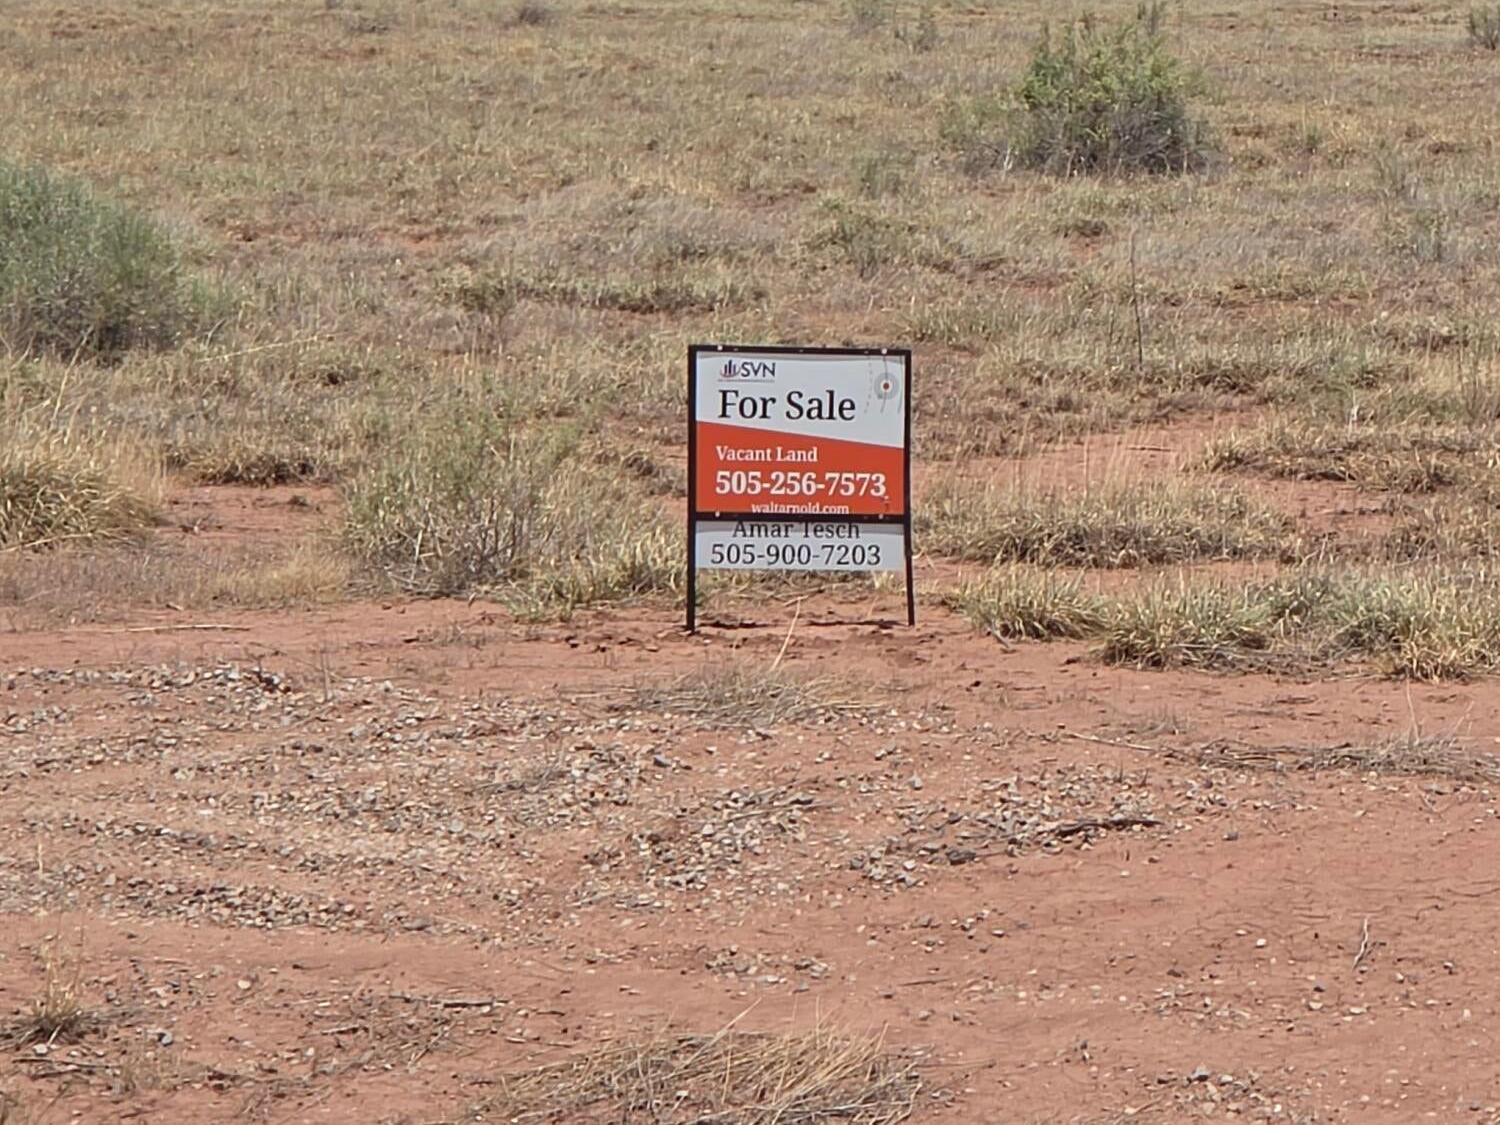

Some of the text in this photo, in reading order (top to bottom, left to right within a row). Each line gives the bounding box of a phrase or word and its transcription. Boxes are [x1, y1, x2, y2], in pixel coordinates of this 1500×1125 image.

[740, 361, 776, 377] SVN
[717, 389, 856, 421] For Sale
[716, 445, 818, 463] Vacant Land
[715, 470, 886, 497] 505-256-7573
[732, 520, 860, 539] Amar Tesch
[710, 543, 881, 565] 505-900-7203
